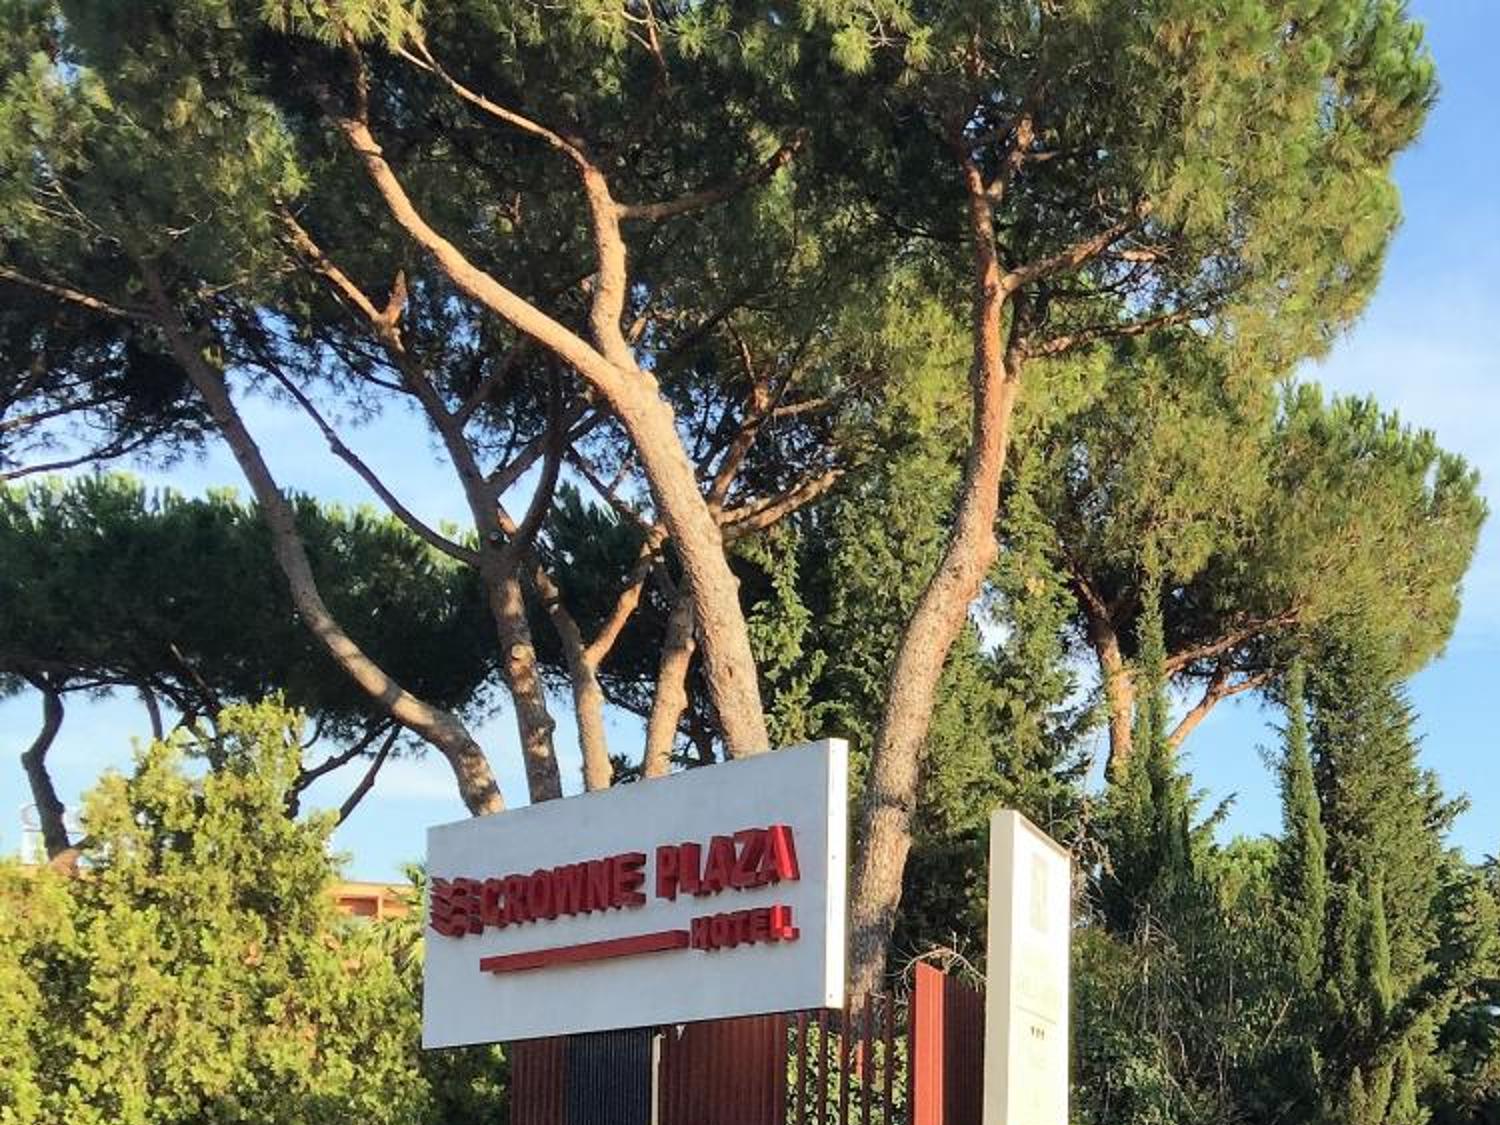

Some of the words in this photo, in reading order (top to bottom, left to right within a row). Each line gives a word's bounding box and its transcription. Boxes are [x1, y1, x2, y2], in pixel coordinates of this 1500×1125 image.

[480, 852, 647, 928] CROWNE
[656, 825, 800, 901] PLAZA
[690, 904, 800, 951] HOTEL
